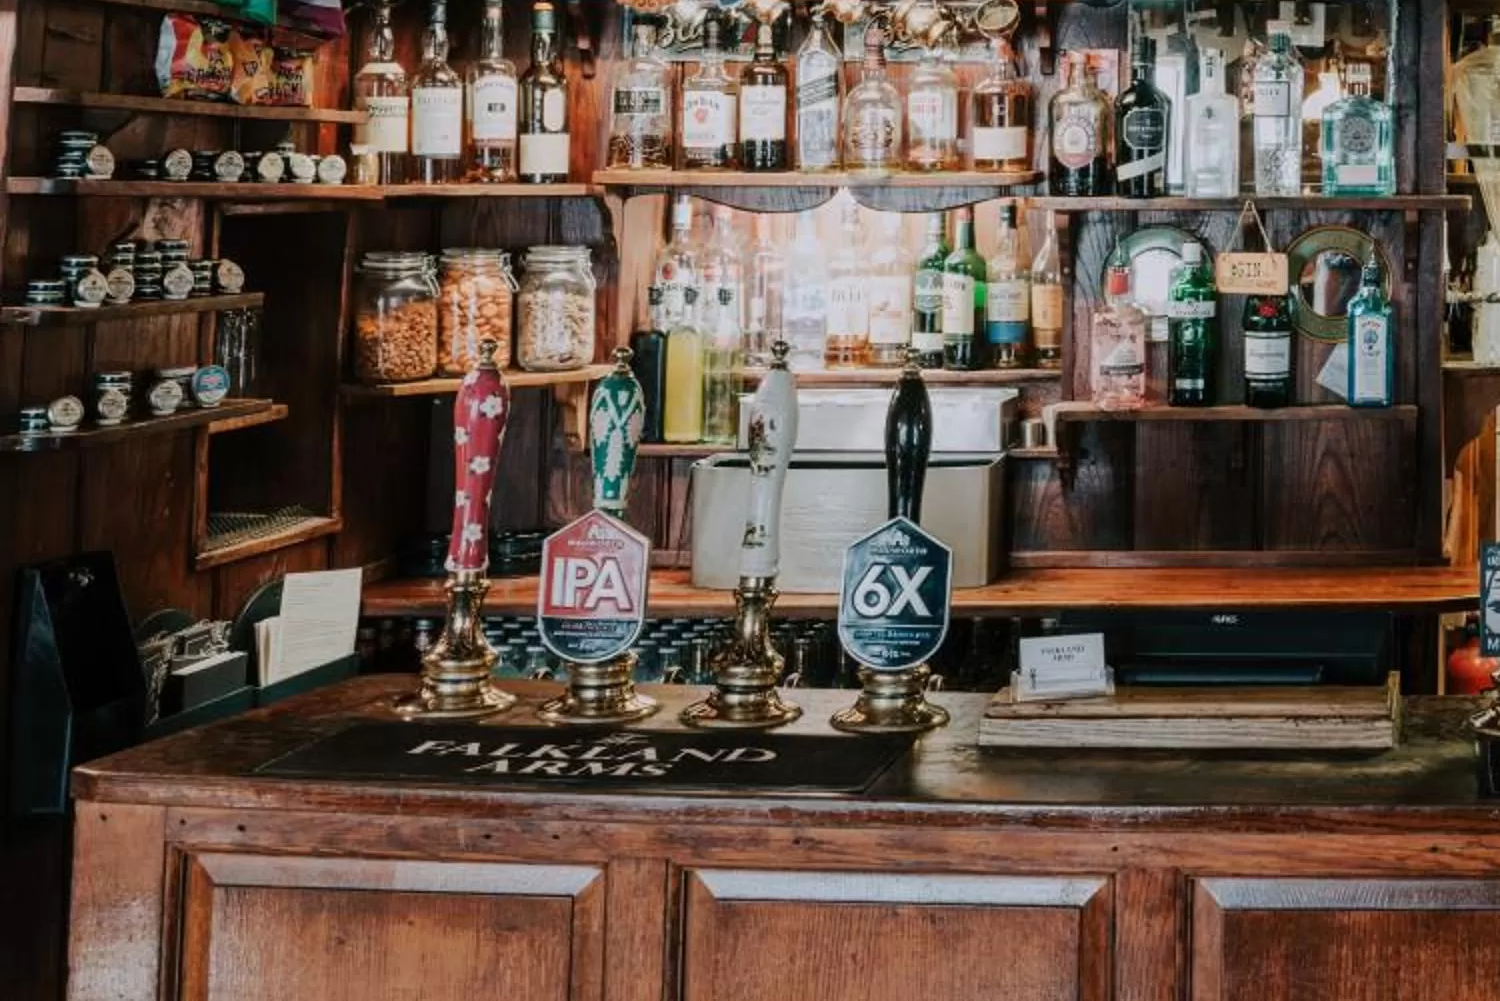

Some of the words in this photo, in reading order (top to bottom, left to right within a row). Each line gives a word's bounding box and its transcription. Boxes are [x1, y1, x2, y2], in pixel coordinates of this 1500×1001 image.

[550, 556, 635, 612] IPA
[852, 562, 936, 618] 6X
[408, 739, 778, 763] FALKLAND
[463, 758, 673, 777] ARMS
